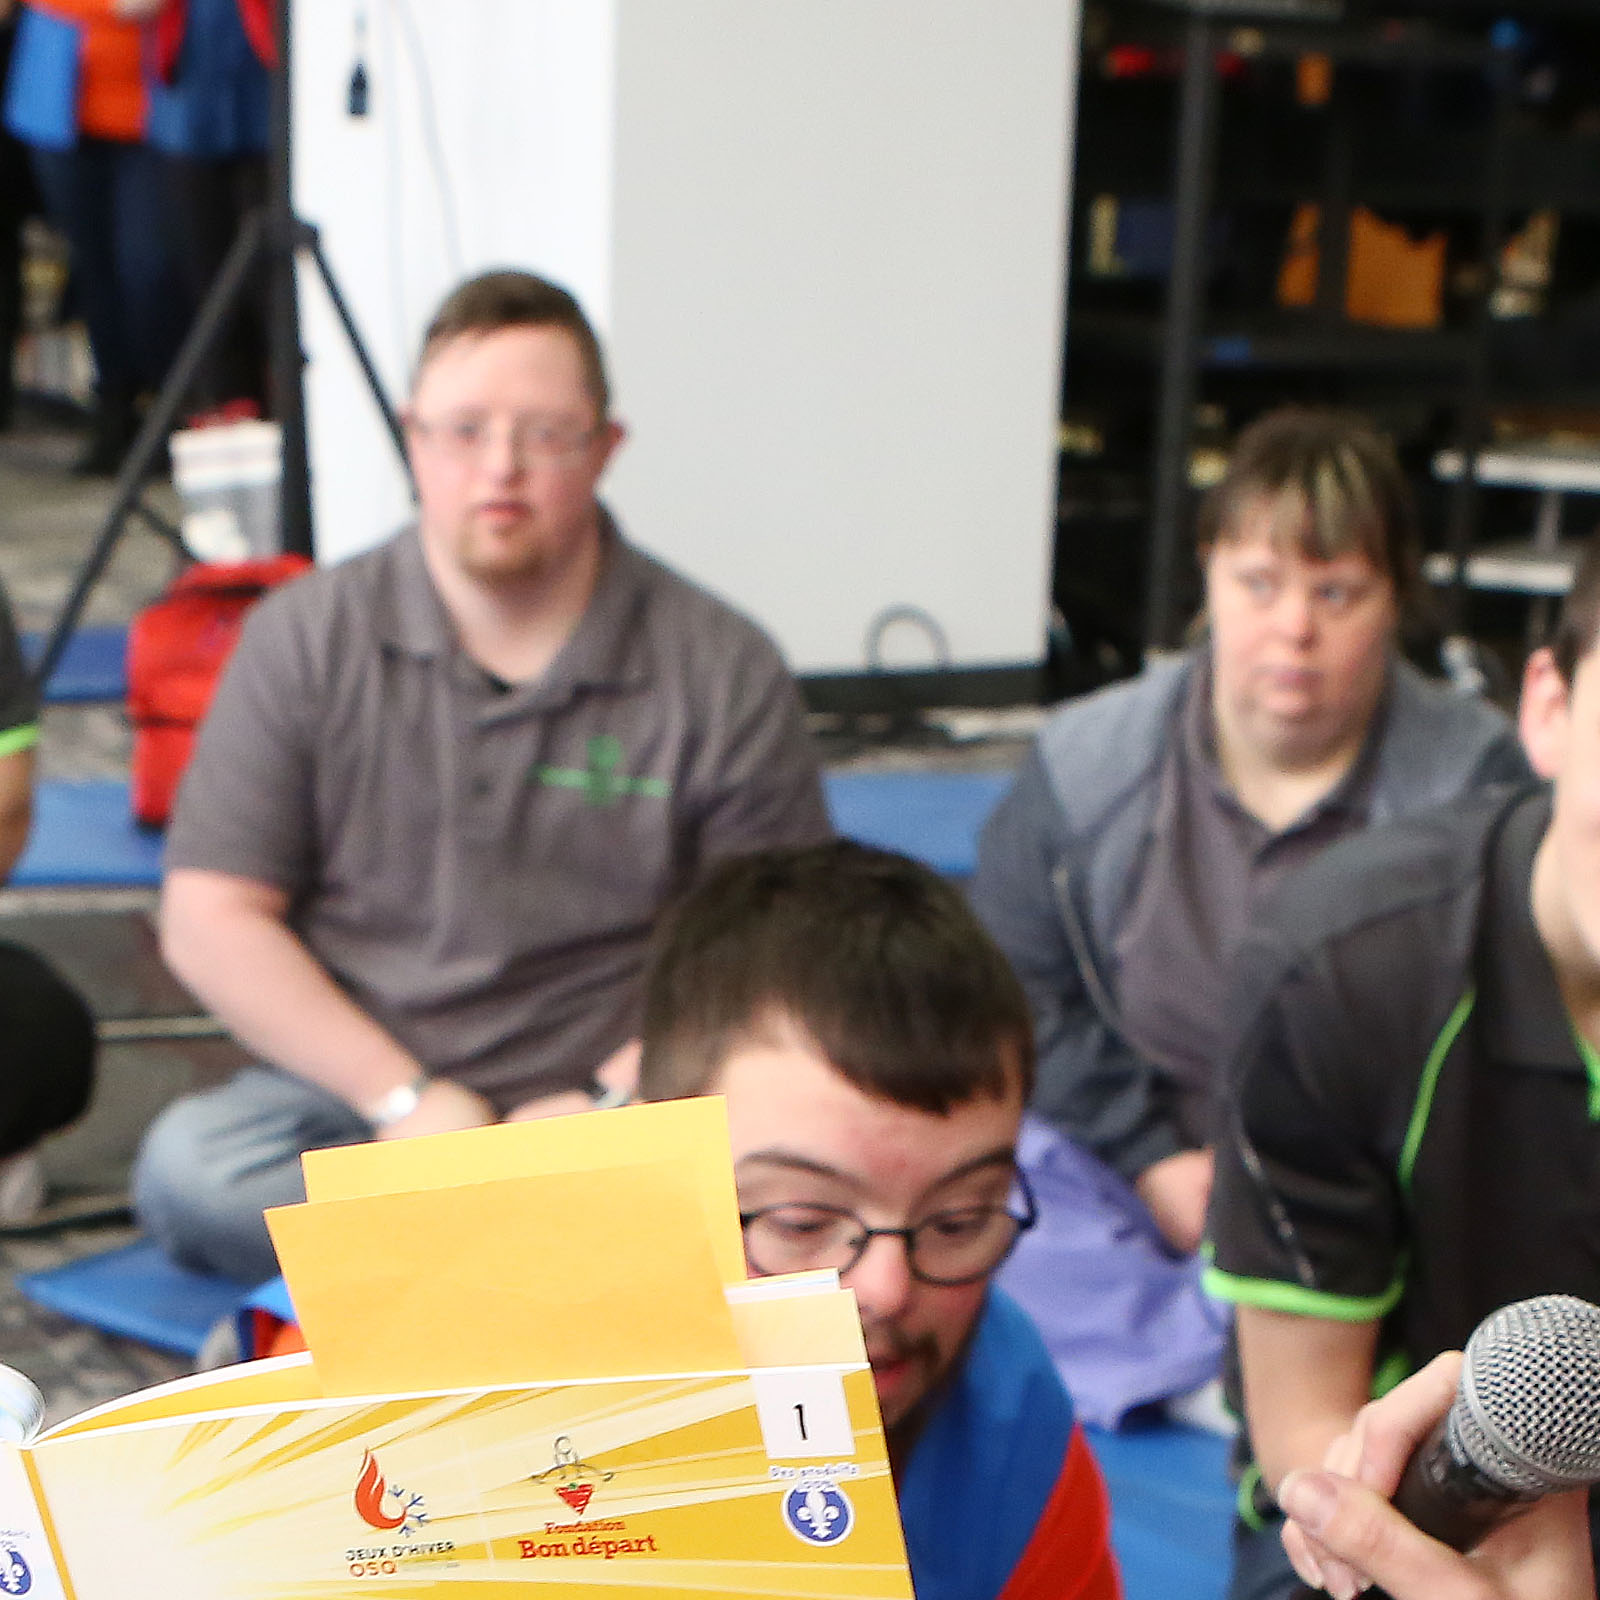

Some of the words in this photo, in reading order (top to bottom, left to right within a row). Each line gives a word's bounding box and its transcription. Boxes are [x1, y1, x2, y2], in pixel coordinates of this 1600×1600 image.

[793, 1404, 808, 1441] 1
[345, 1546, 387, 1562] JEUX
[349, 1560, 398, 1578] OSQ
